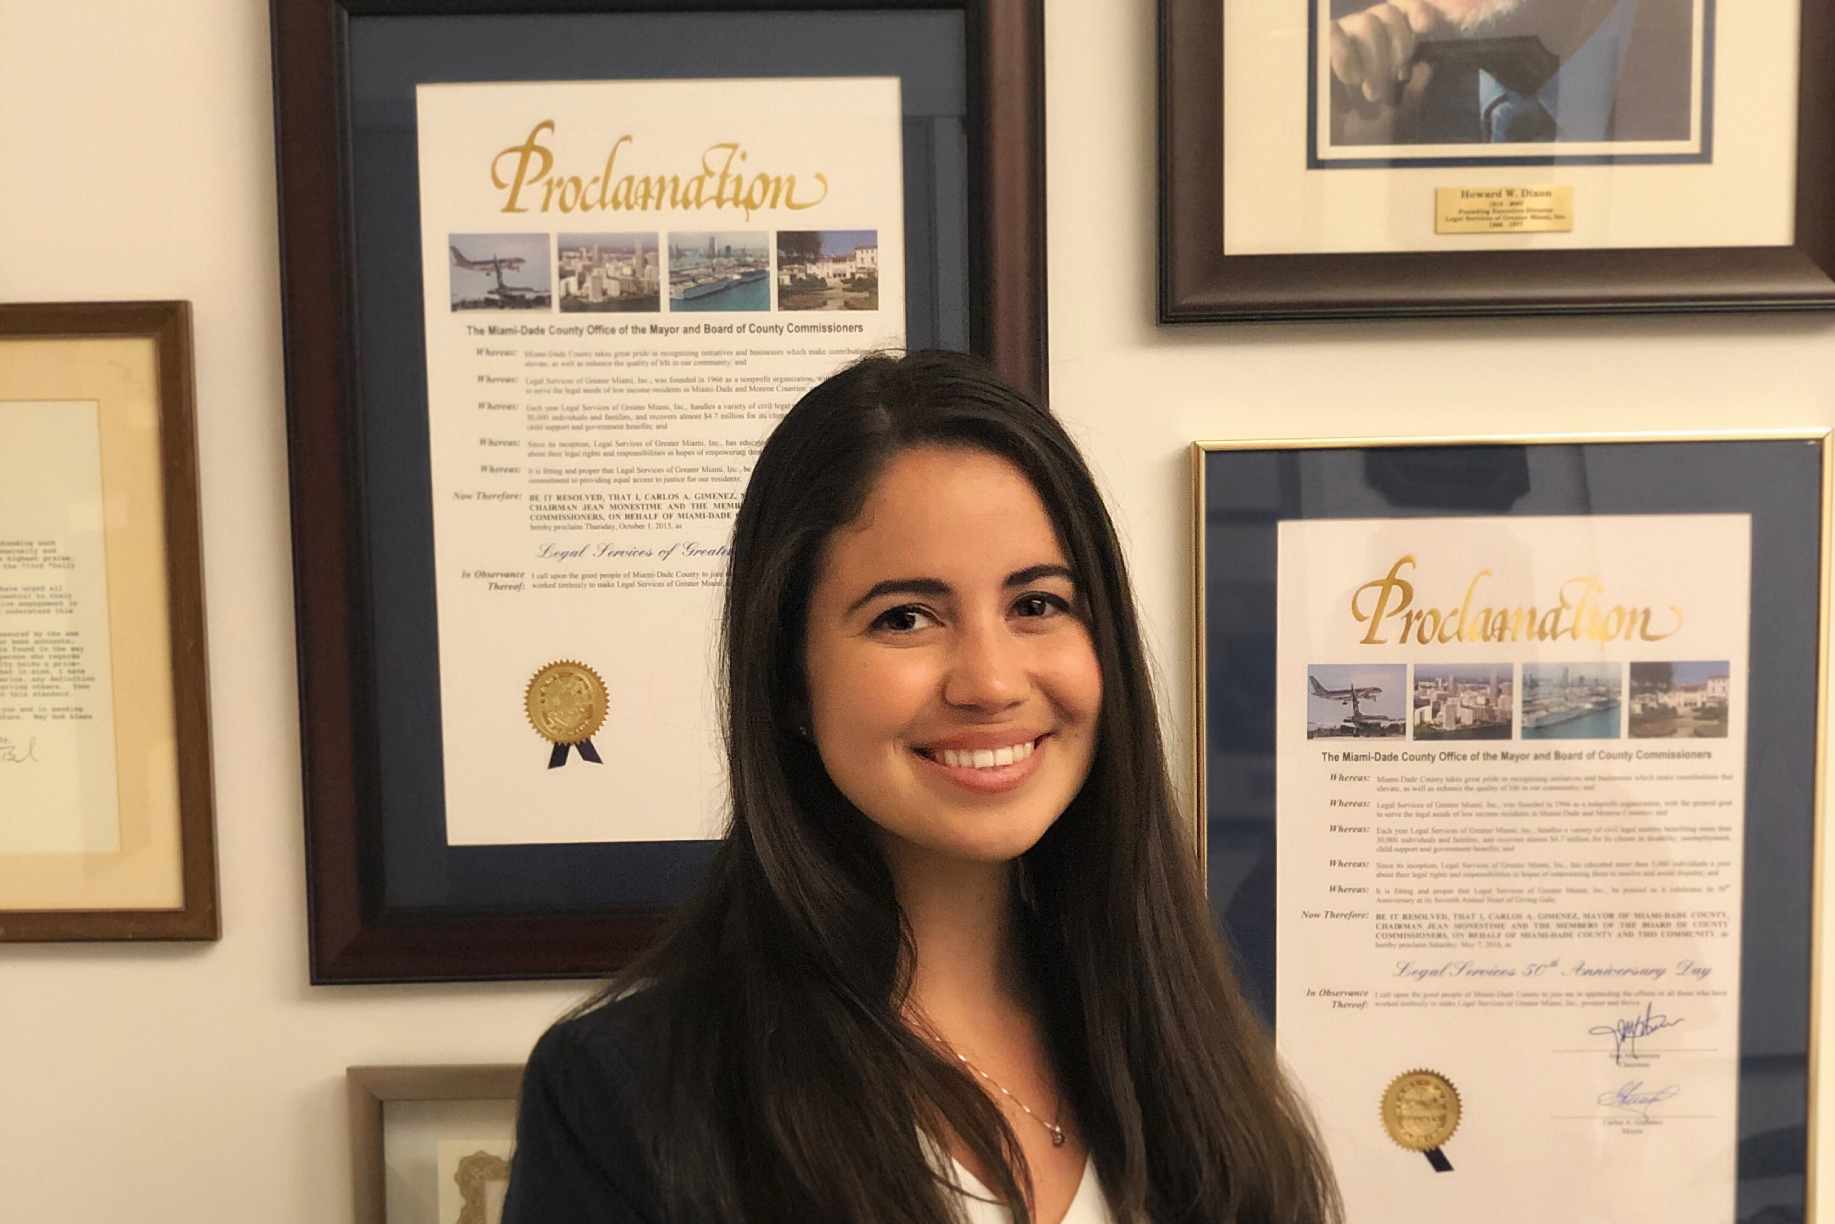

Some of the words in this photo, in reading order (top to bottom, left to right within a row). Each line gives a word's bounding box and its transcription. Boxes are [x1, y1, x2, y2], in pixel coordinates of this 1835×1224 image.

[1461, 190, 1502, 199] Howard
[1506, 189, 1518, 198] W.
[1521, 189, 1552, 198] Dixon
[467, 326, 485, 336] The
[487, 326, 545, 336] Miami-Dade
[548, 325, 584, 338] County
[586, 325, 616, 335] Office
[618, 325, 629, 335] of
[631, 325, 647, 335] the
[649, 324, 679, 338] Mayor
[682, 324, 701, 335] and
[703, 324, 733, 334] Board
[736, 324, 746, 334] of
[748, 324, 784, 337] County
[786, 323, 863, 334] Commissioners
[476, 348, 517, 356] Whereas:
[480, 438, 520, 447] Whereas:
[480, 465, 521, 473] Whereas:
[476, 492, 522, 502] Therefore:
[556, 494, 605, 502] RESOLVED,
[635, 493, 642, 502] I,
[694, 492, 739, 501] GIMENEZ,
[529, 514, 605, 522] COMMISSIONERS,
[536, 544, 591, 562] Legal
[592, 542, 653, 557] Services
[657, 543, 682, 561] of
[461, 571, 471, 579] In
[474, 570, 525, 579] Observance
[488, 582, 525, 591] Thereof:
[1322, 752, 1340, 762] The
[1342, 752, 1399, 762] Miami-Dade
[1401, 751, 1436, 764] County
[1438, 751, 1468, 762] Office
[1470, 751, 1480, 761] of
[1482, 751, 1498, 761] the
[1500, 751, 1530, 764] Mayor
[1533, 751, 1551, 761] and
[1553, 750, 1583, 761] Board
[1585, 750, 1596, 761] of
[1598, 750, 1633, 763] County
[1635, 750, 1712, 760] Commissioners
[1330, 800, 1370, 808] Whereas:
[1329, 825, 1370, 833] Whereas:
[1329, 860, 1370, 868] Whereas:
[1329, 885, 1369, 893] Whereas:
[1301, 911, 1321, 919] Now
[1324, 911, 1369, 921] Therefore:
[1392, 961, 1450, 981] Legal
[1450, 961, 1516, 977] Services
[1561, 960, 1667, 980] Anniversary
[1674, 959, 1712, 980] Day
[1306, 989, 1316, 997] In
[1318, 989, 1369, 997] Observance
[1331, 1001, 1369, 1009] Thereof:
